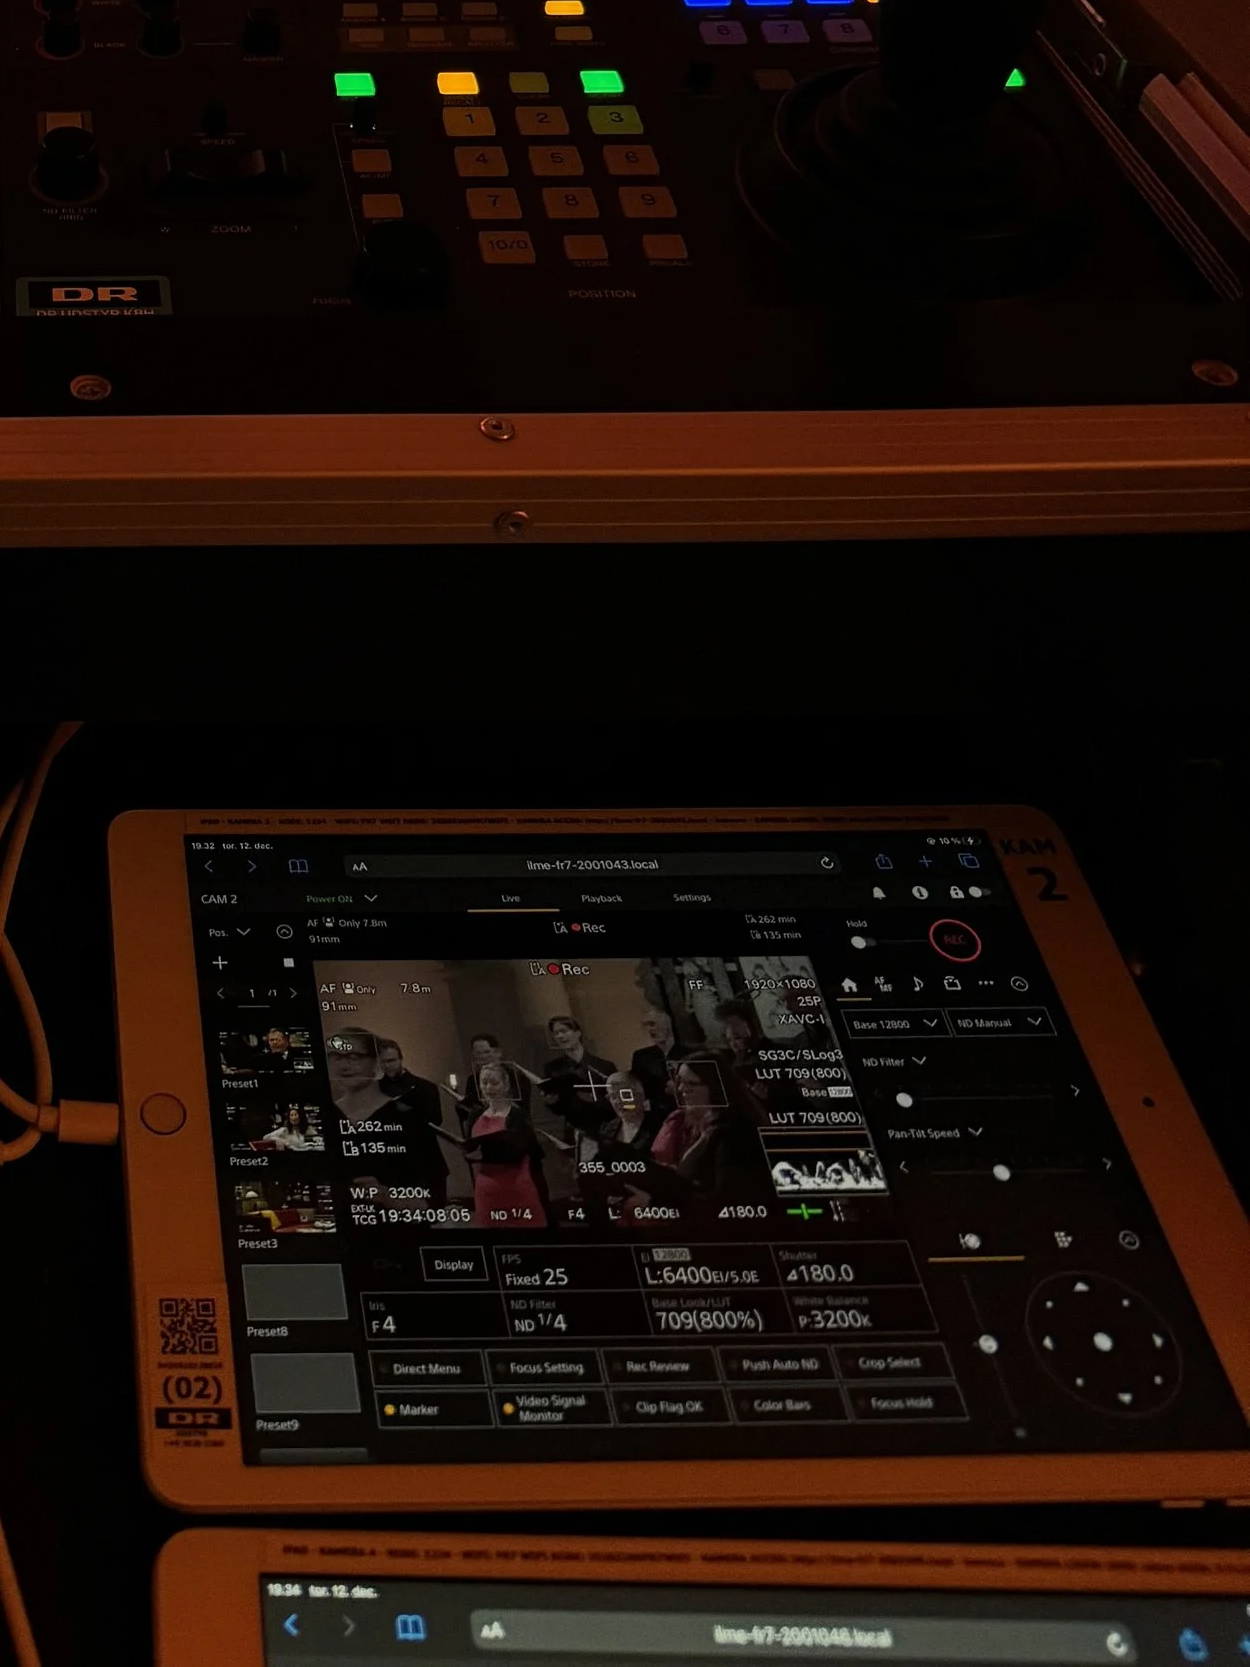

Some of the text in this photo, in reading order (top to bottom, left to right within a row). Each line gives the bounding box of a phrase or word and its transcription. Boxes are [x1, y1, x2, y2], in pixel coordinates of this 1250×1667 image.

[210, 225, 251, 233] ZOOM
[51, 287, 139, 302] DR
[191, 842, 273, 850] 19.32 tor. 12. dec.
[1001, 838, 1057, 854] KAM
[527, 859, 659, 870] ilme-fr7-2001043.local
[1027, 867, 1068, 901] 2
[201, 894, 226, 904] CAM
[307, 895, 352, 903] Power ON
[582, 923, 606, 933] Rec
[562, 964, 589, 975] Rec
[758, 1050, 843, 1062] SG3C/SLog3
[755, 1067, 846, 1080] LUT 709(800)
[222, 1078, 258, 1089] Preset1
[768, 1112, 862, 1125] LUT 709(800)
[230, 1156, 269, 1167] Preset2
[579, 1162, 646, 1175] 355_0003
[353, 1208, 470, 1226] TCG 19:34:08:05
[238, 1239, 278, 1250] Preset3
[434, 1259, 473, 1272] Display
[506, 1269, 569, 1286] Fixed 25
[655, 1310, 764, 1332] 709(800%)
[393, 1363, 461, 1374] Direct Menu
[510, 1362, 585, 1377] Focus Setting
[162, 1376, 223, 1404] (02)
[400, 1403, 439, 1416] Marker
[168, 1412, 221, 1427] DR
[519, 1410, 564, 1422] Monitor
[256, 1420, 301, 1432] Preset9
